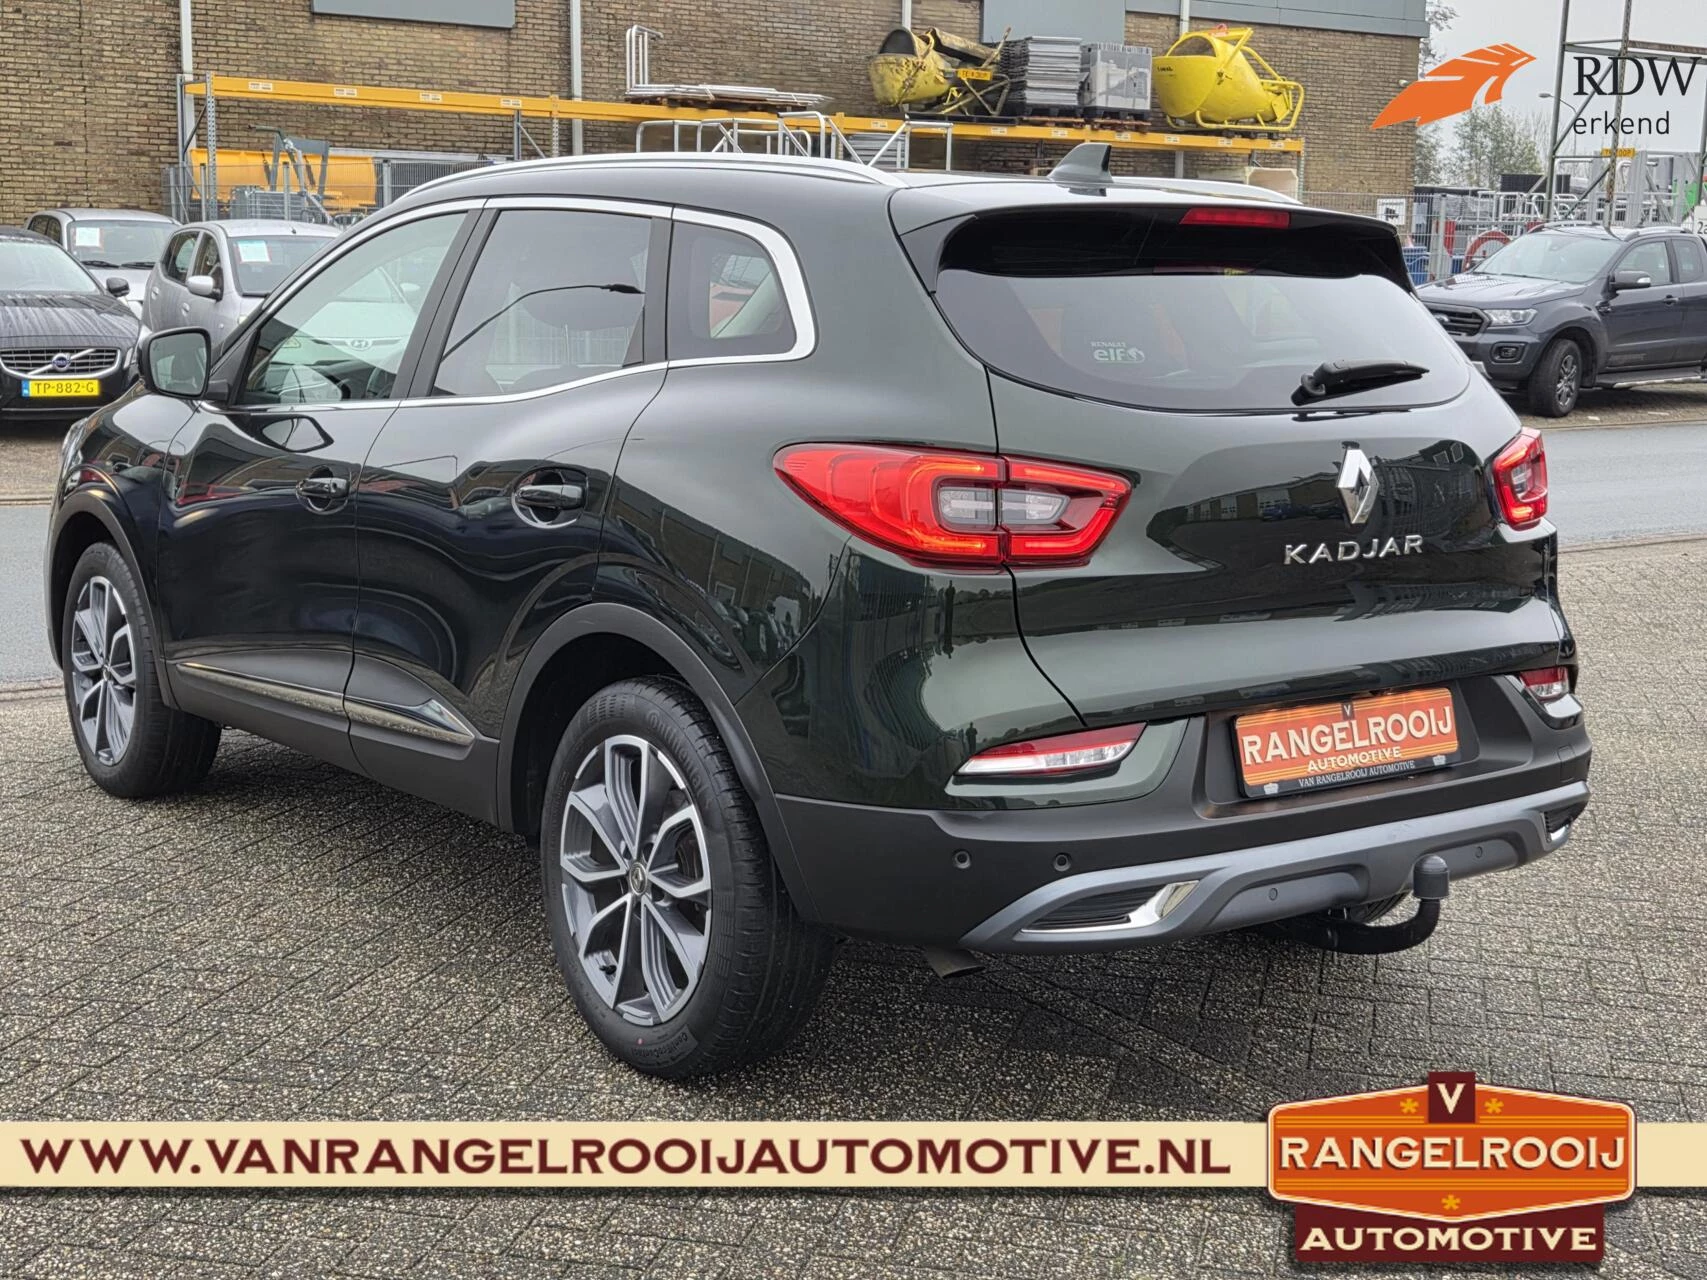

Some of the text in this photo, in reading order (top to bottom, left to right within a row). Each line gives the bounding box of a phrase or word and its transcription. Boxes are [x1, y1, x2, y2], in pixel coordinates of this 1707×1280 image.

[34, 382, 94, 394] TP-882-G
[1283, 534, 1424, 565] KADJAR
[1242, 706, 1453, 766] RANGELROOIJ
[1307, 746, 1402, 773] AUTOMOTIVE
[1298, 760, 1416, 788] VAN RANGELROOIJ AUTOMOTIVE
